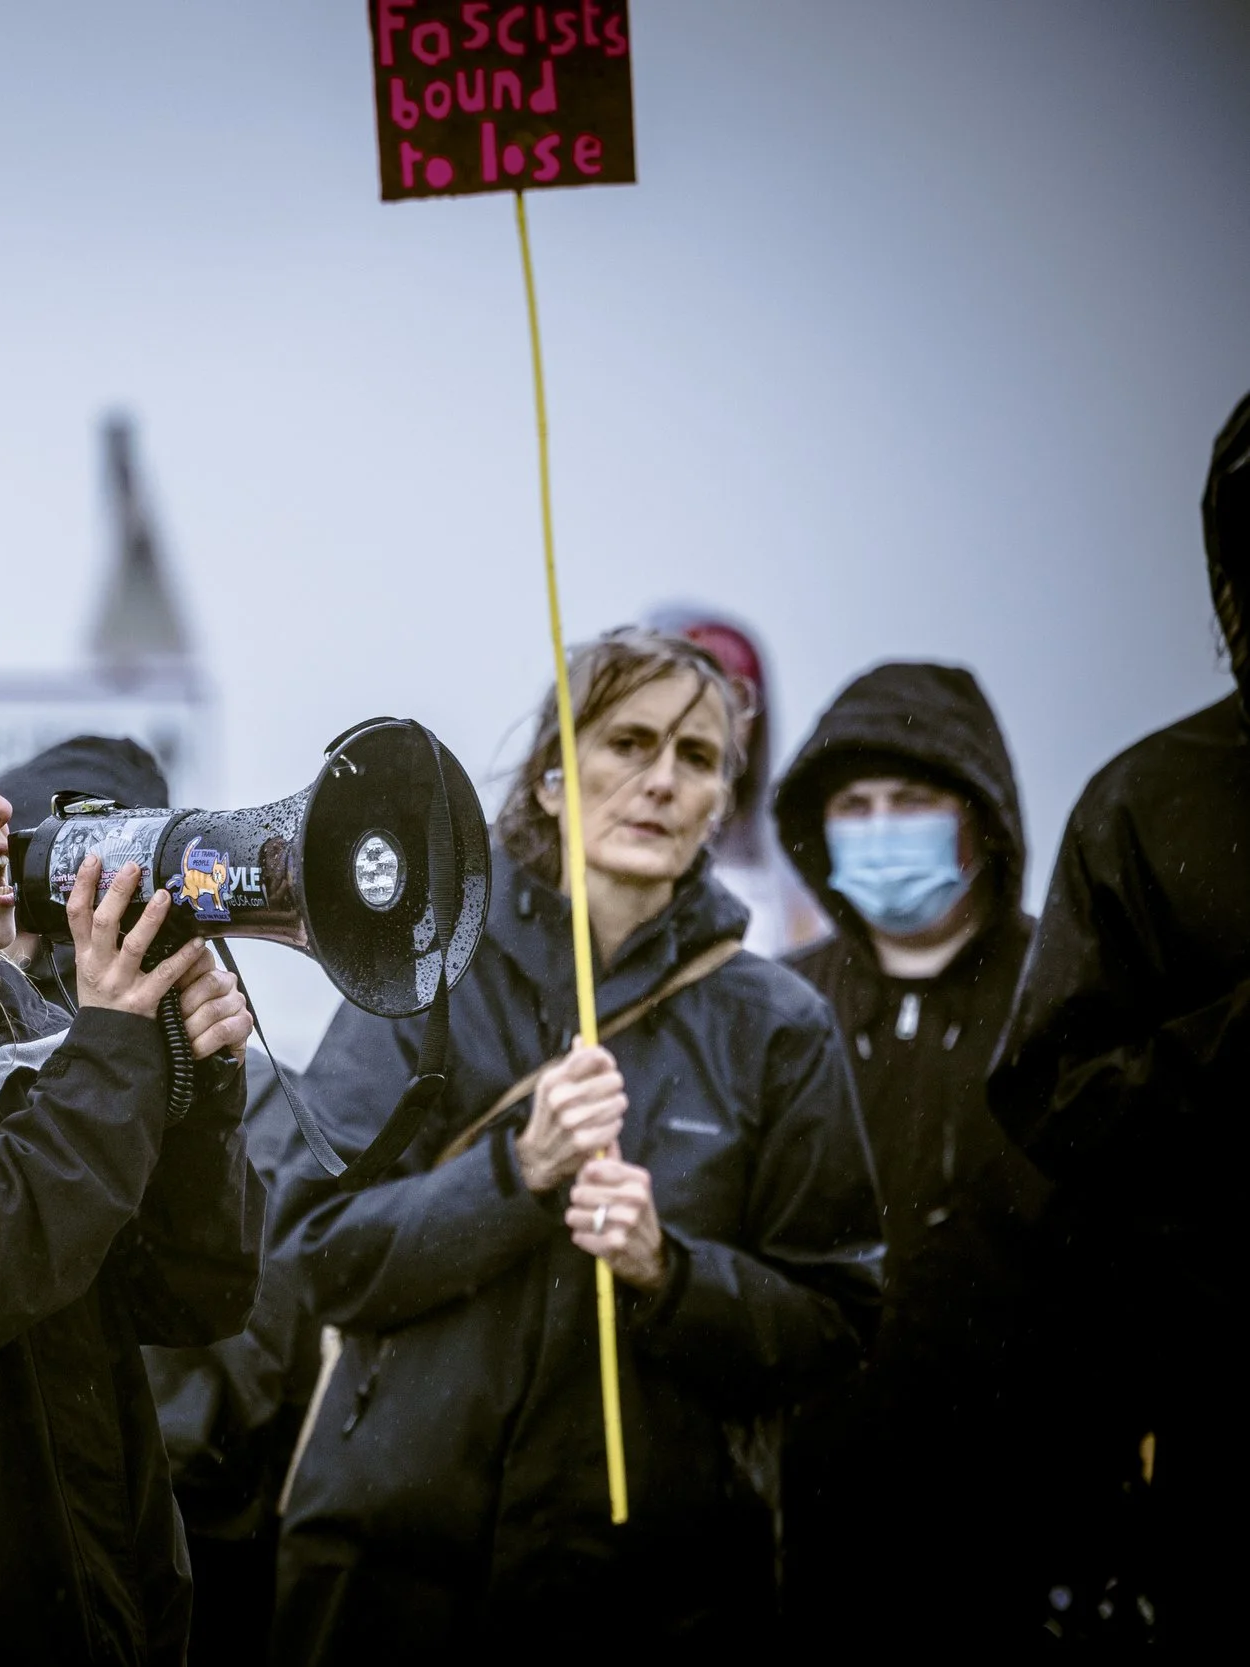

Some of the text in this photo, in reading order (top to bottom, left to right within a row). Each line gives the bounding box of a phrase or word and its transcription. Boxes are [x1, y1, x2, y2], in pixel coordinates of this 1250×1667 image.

[377, 0, 628, 66] Fascists
[389, 59, 559, 130] bound
[399, 120, 602, 188] to lose
[229, 866, 262, 892] YLE
